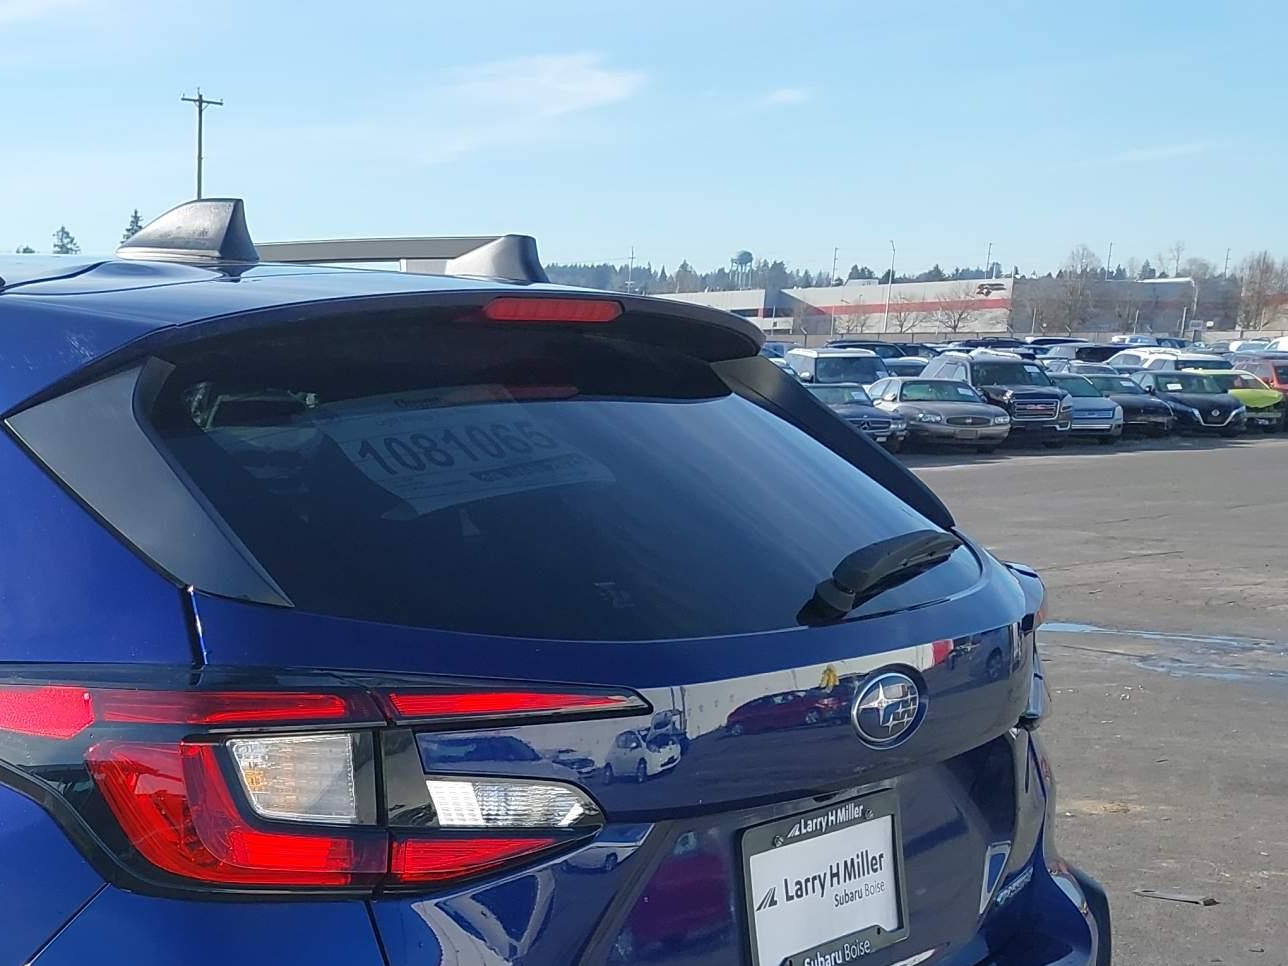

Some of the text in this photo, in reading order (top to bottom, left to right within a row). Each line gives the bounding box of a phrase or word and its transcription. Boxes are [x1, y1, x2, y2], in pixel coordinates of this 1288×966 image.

[357, 420, 559, 477] 1081065
[800, 803, 864, 833] Larry H Miller
[783, 849, 884, 902] Larry H Miller
[834, 880, 885, 908] Subaru Boise
[843, 939, 872, 962] Boise
